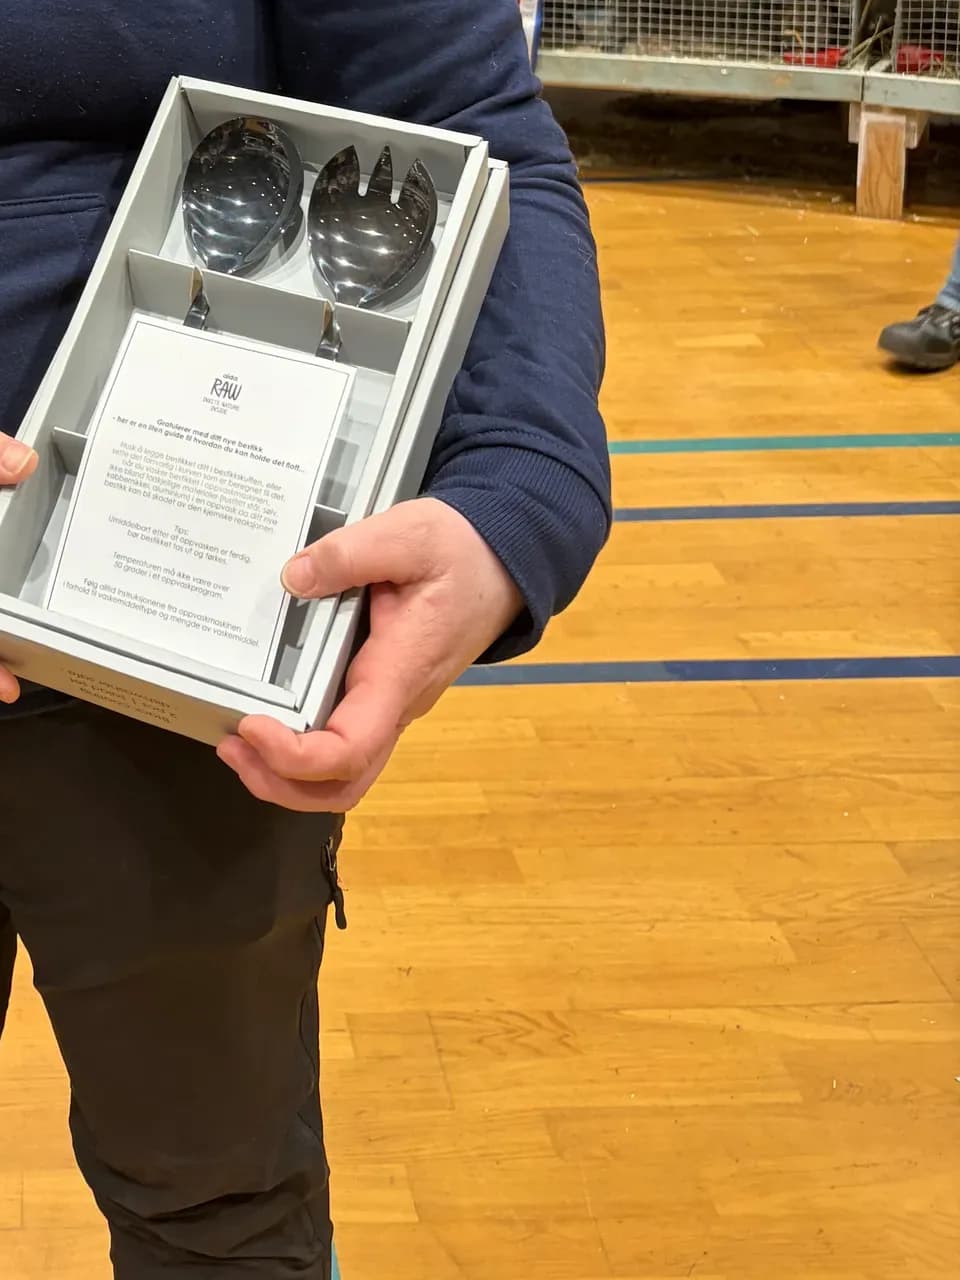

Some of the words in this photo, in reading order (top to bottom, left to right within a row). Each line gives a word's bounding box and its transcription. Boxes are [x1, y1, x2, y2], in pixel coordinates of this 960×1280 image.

[210, 377, 242, 401] RAW
[147, 424, 163, 433] liten
[163, 429, 184, 440] guide
[193, 436, 222, 449] hvordan
[234, 448, 248, 456] kan
[249, 452, 271, 462] holde
[271, 458, 285, 466] det
[155, 419, 191, 432] Gratulerer
[192, 429, 209, 437] med
[209, 433, 221, 441] ditt
[222, 438, 235, 446] nye
